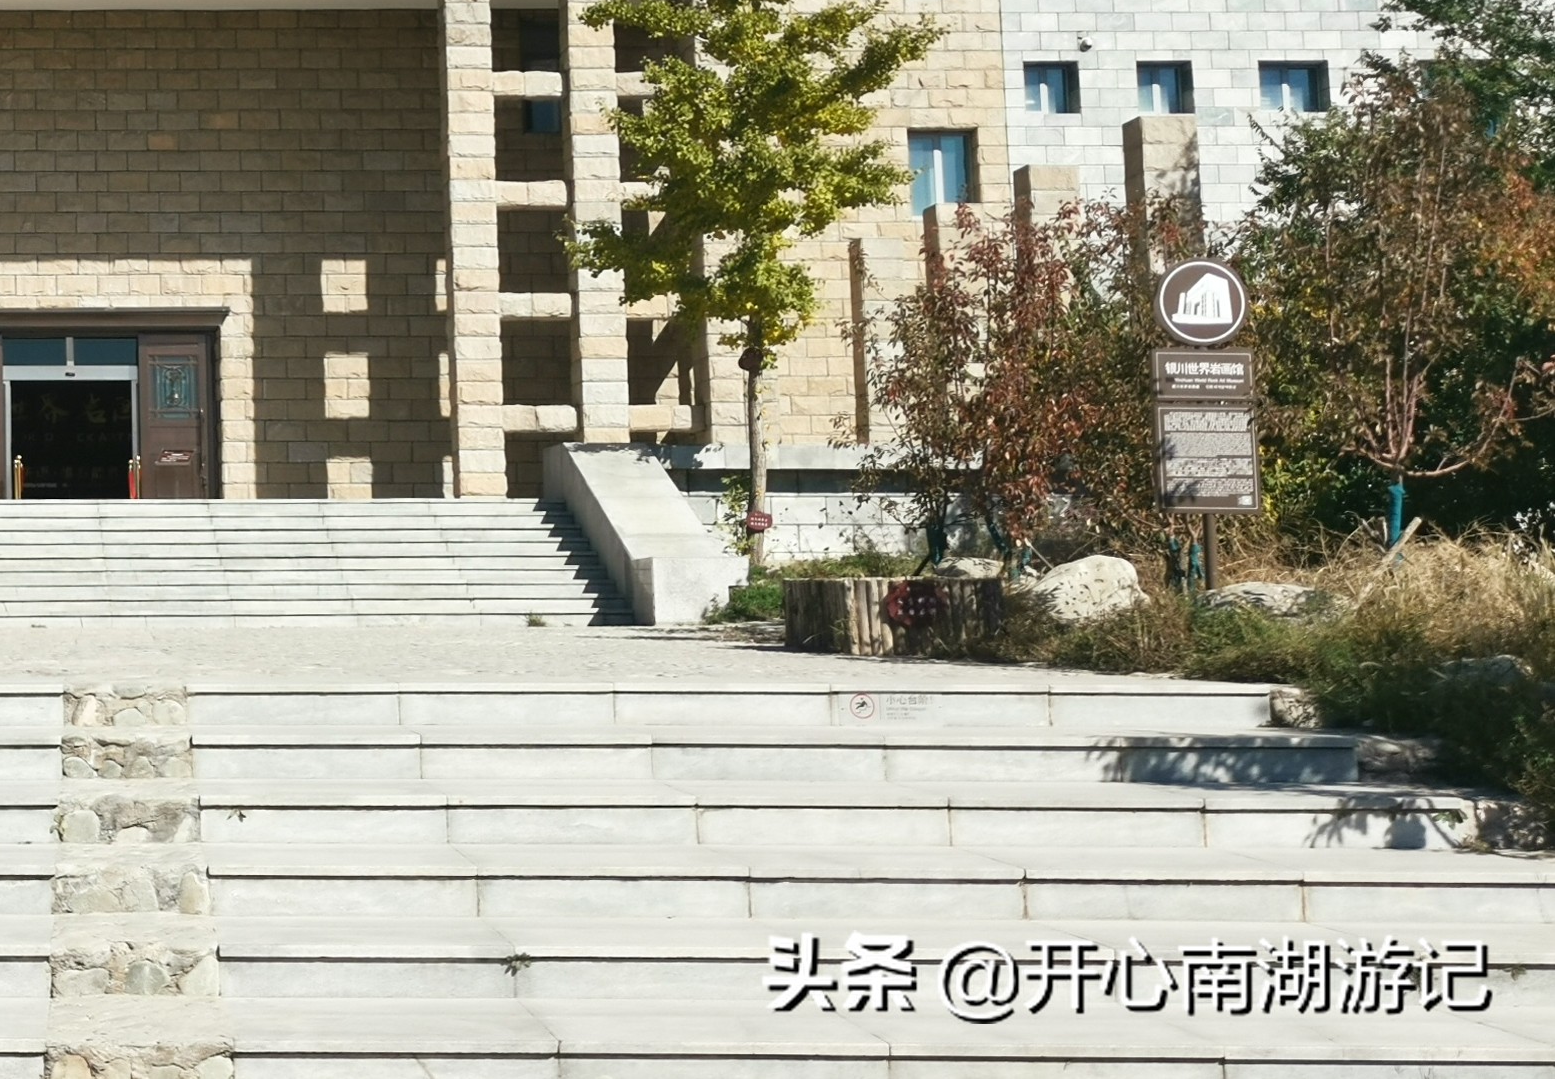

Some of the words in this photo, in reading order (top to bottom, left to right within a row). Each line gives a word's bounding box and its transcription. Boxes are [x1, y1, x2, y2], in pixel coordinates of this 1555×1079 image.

[1165, 361, 1244, 376] 银川世界岩画馆
